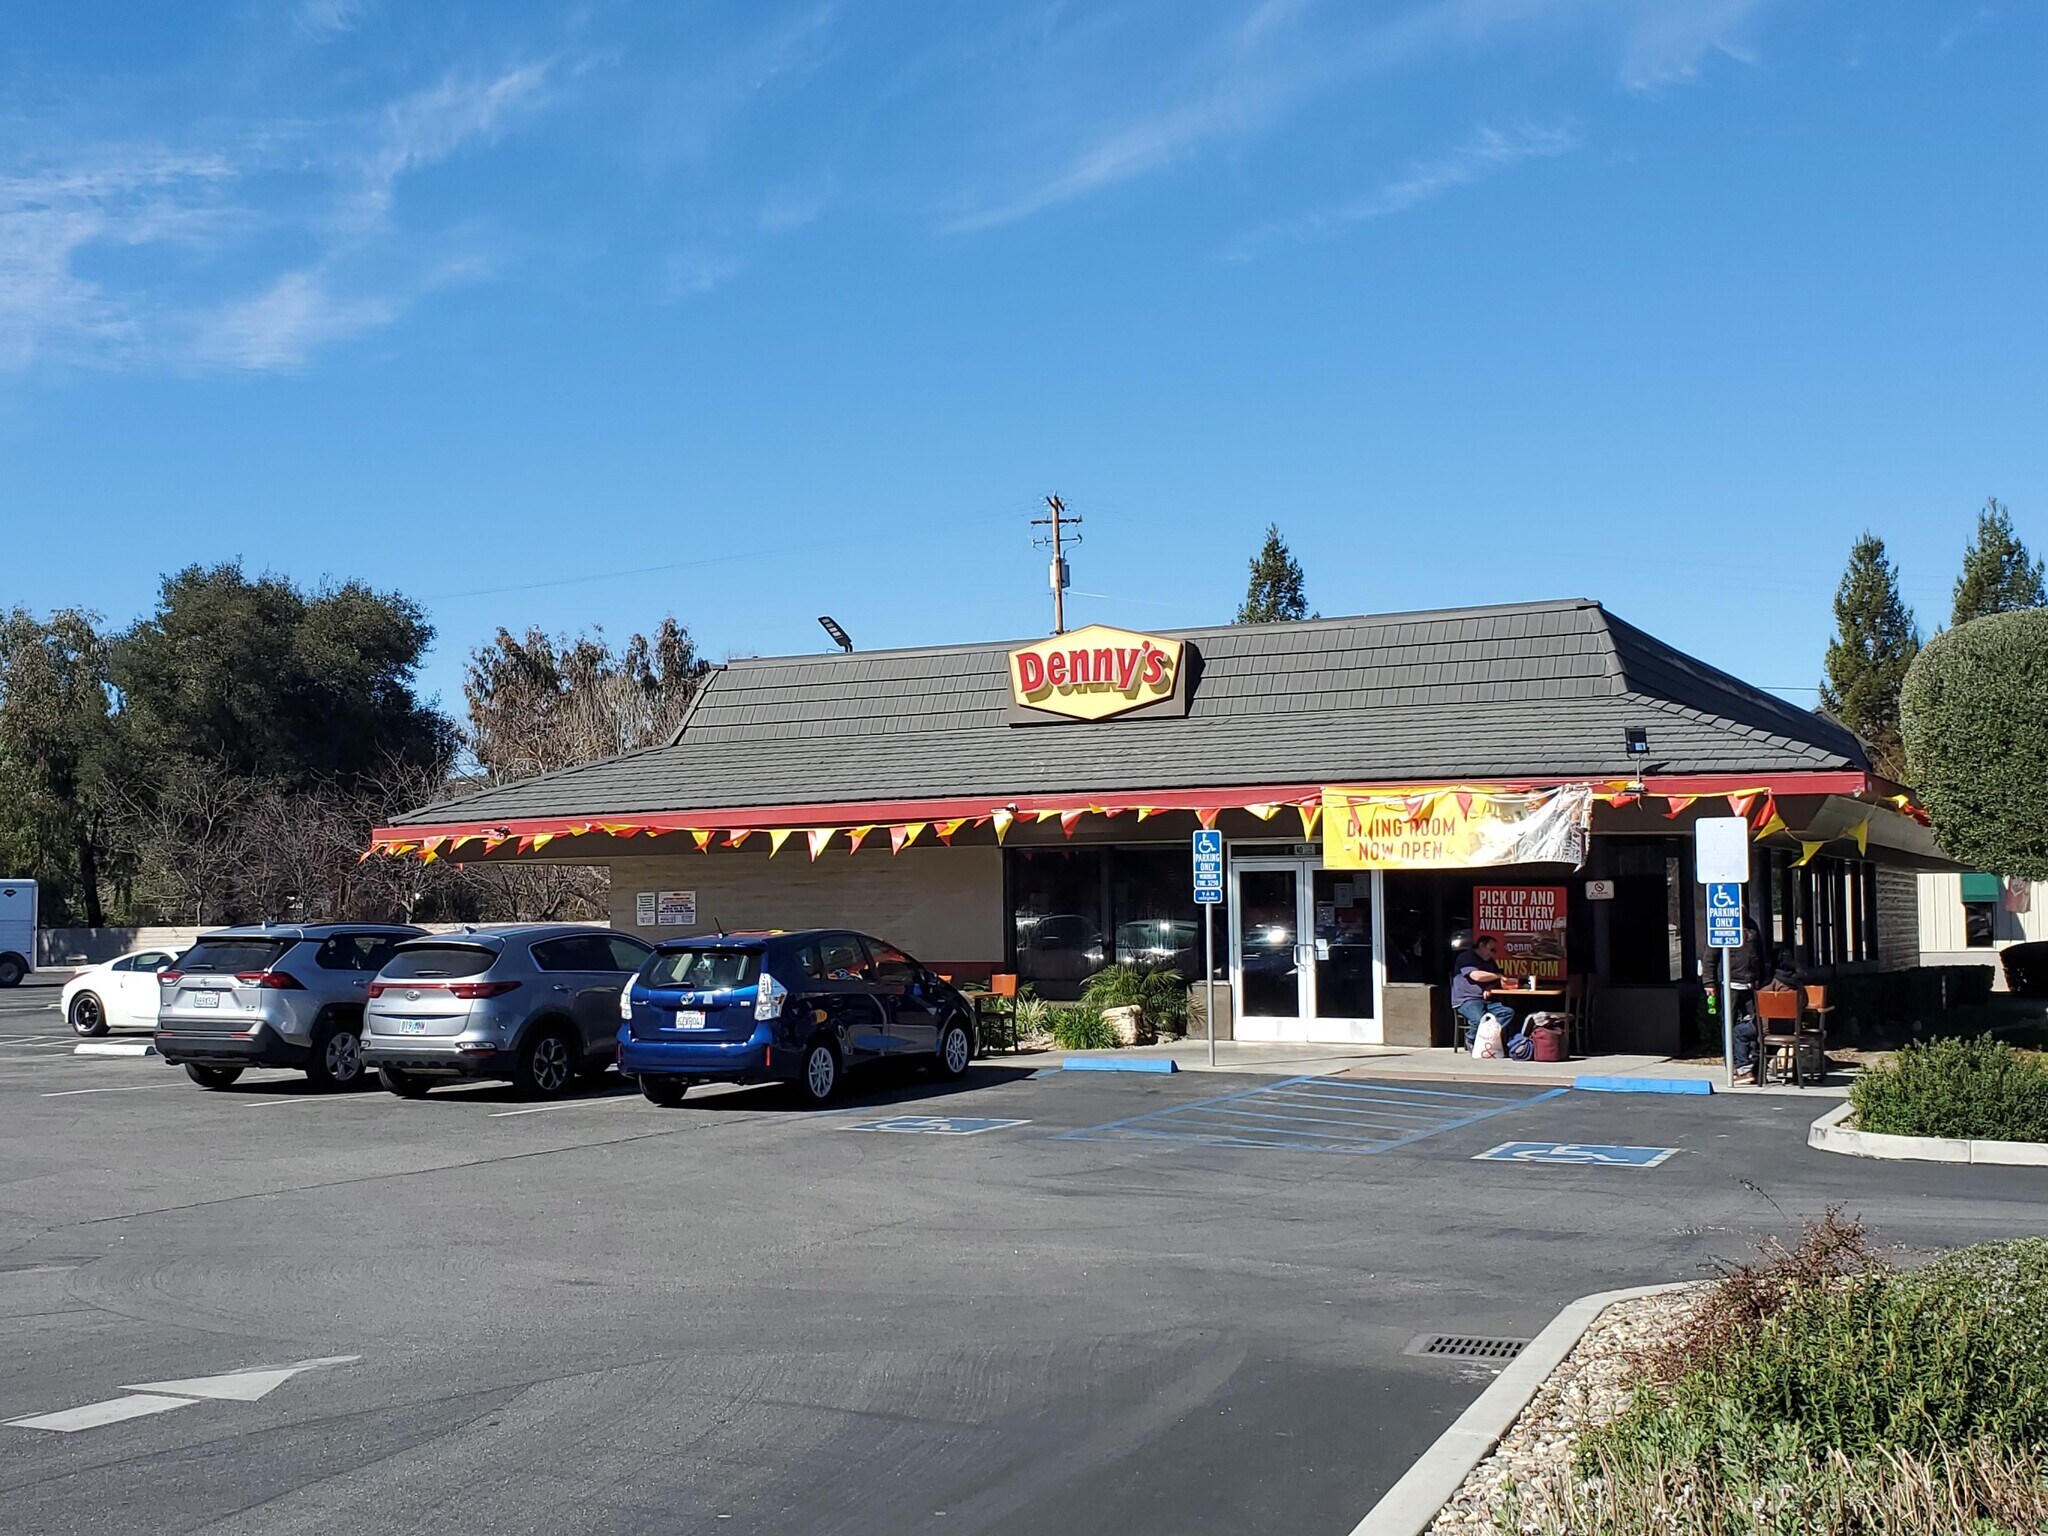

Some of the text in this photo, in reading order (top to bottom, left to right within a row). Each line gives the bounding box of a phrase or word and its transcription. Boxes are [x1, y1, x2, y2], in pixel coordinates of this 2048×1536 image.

[1015, 640, 1166, 693] Denny's
[1359, 841, 1442, 861] NOW OPEN
[1195, 853, 1220, 863] PARKING
[1200, 862, 1215, 871] ONLY
[1479, 890, 1555, 906] PICK UP AND
[1479, 905, 1555, 919] FREE DELIVERY
[1709, 907, 1740, 918] PARKING
[1479, 918, 1553, 932] AVAILABLE NOW
[1715, 917, 1734, 928] ONLY
[1724, 937, 1739, 945] $250
